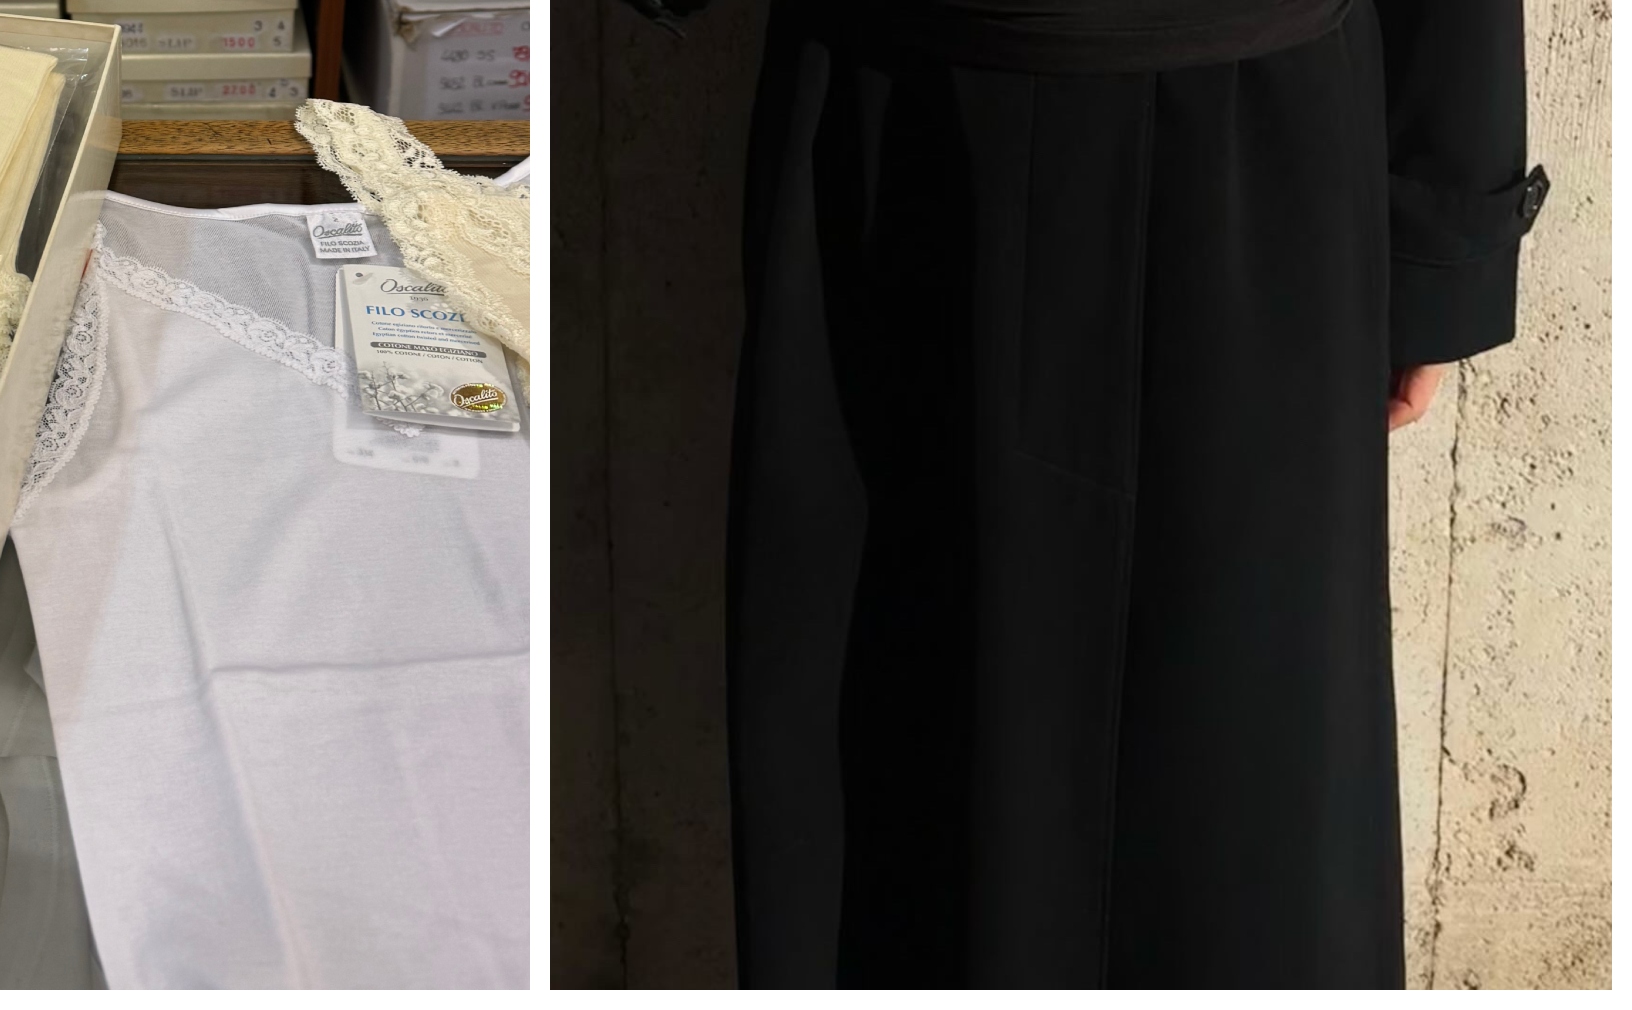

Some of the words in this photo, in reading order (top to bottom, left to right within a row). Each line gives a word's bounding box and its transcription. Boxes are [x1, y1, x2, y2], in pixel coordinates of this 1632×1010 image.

[313, 221, 363, 238] Oscalito
[352, 245, 370, 253] ITALY
[366, 305, 405, 317] FILO
[410, 308, 465, 323] SCOZI
[378, 342, 412, 350] COTONE
[453, 389, 498, 407] Oscalito
